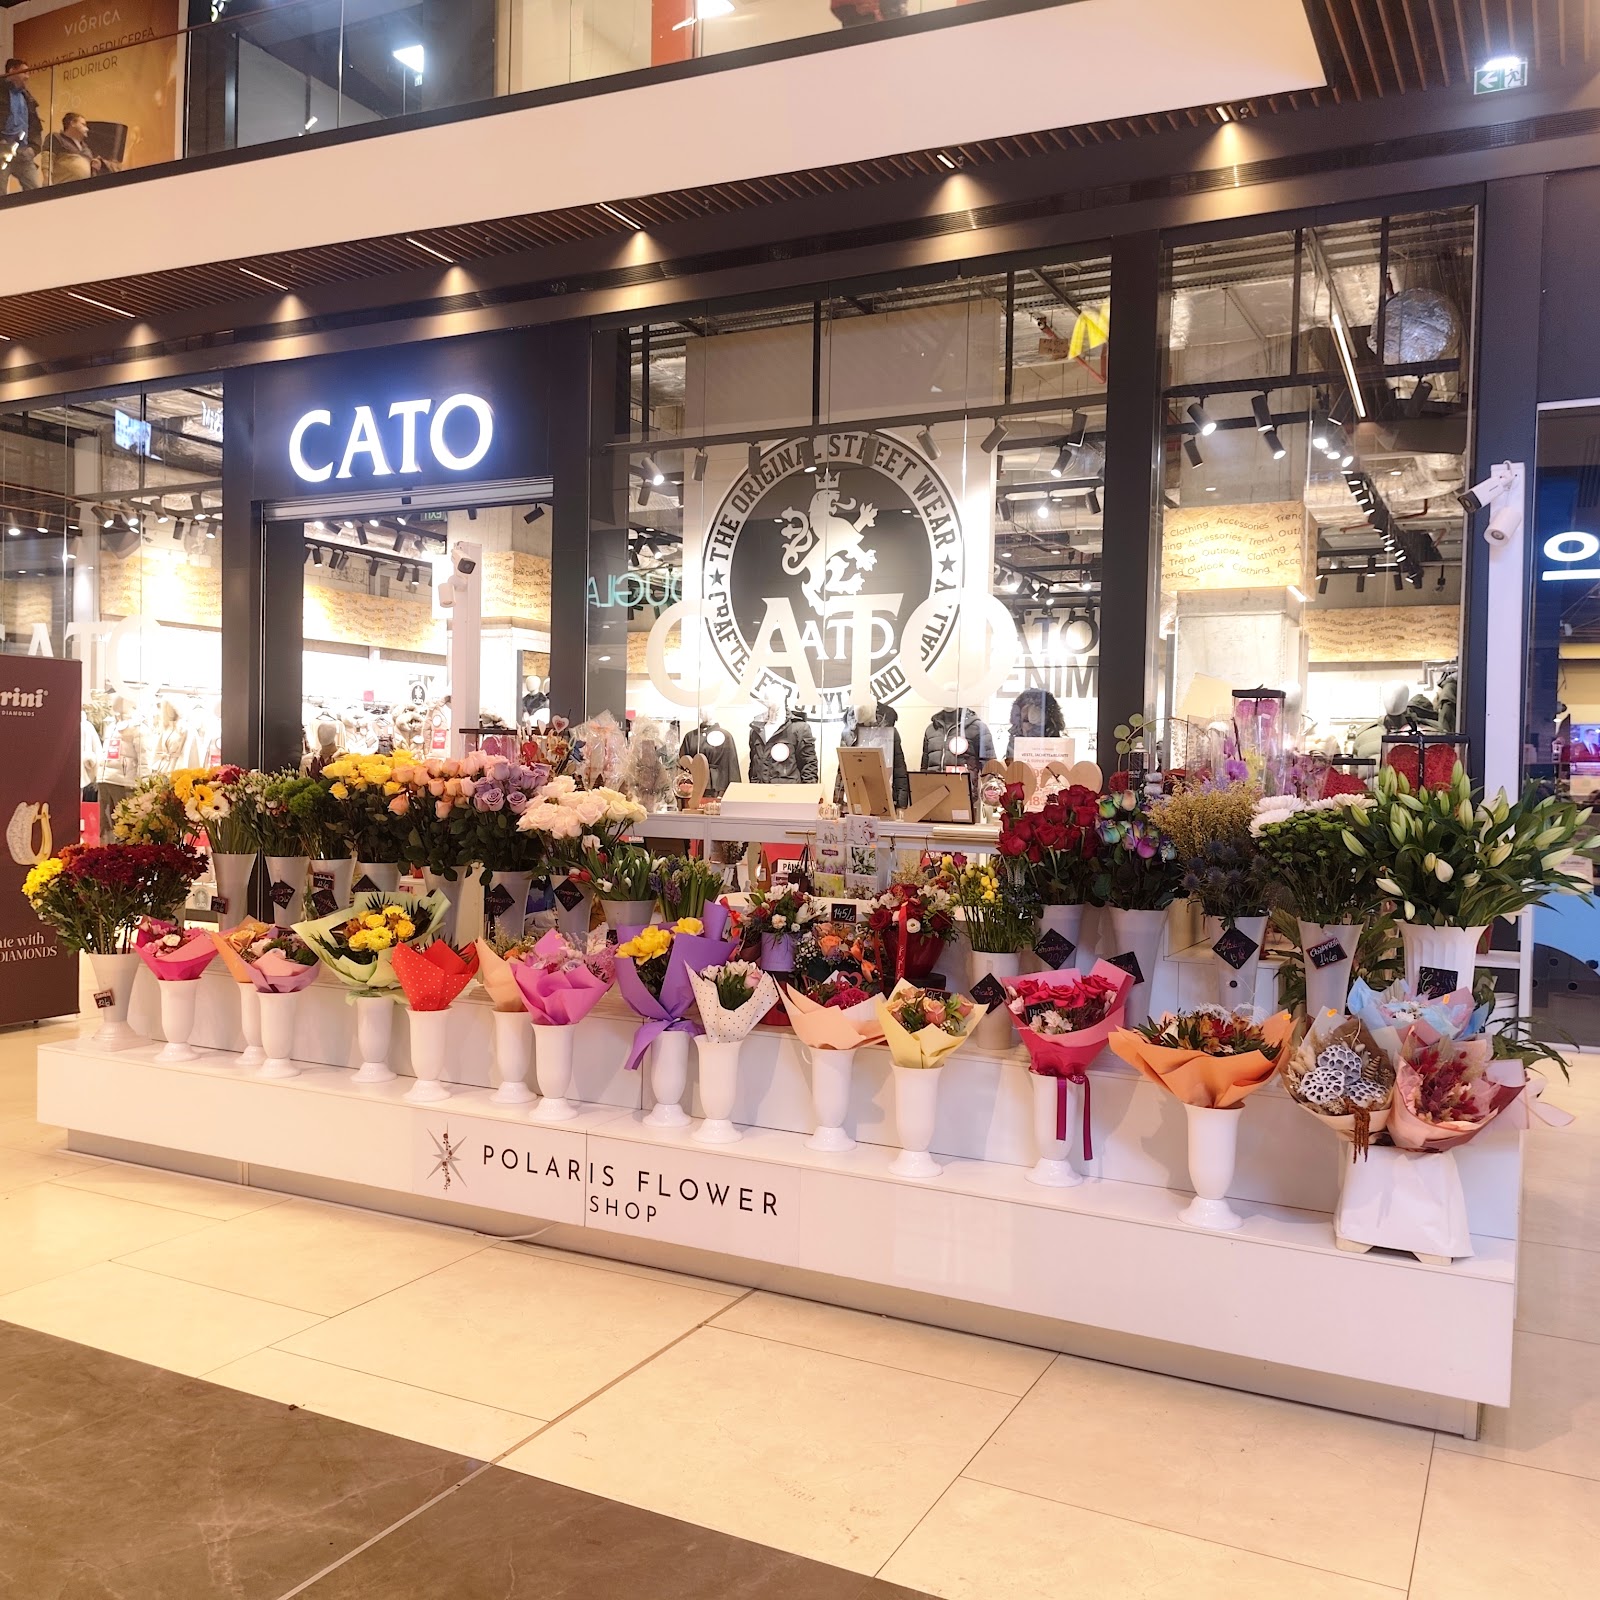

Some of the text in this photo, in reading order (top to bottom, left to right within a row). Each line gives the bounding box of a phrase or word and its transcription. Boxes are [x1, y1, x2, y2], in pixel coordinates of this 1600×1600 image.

[63, 55, 118, 82] RIDURILOR
[289, 393, 493, 482] CATO
[709, 513, 741, 563] THE
[912, 474, 956, 549] WEAR
[1170, 520, 1209, 537] Clothing
[1216, 516, 1270, 531] Accessories
[1188, 532, 1242, 547] Accessories
[1249, 534, 1274, 546] Trend
[1169, 555, 1196, 567] Trend
[1202, 548, 1241, 557] Outlook
[1247, 545, 1286, 561] Clothing
[1187, 562, 1224, 575] Outlook
[1232, 562, 1270, 575] Clothing
[708, 591, 751, 676] CRAFTE
[646, 592, 1018, 707] CATO
[17, 931, 45, 947] with
[484, 1145, 777, 1216] POLARIS FLOWER
[590, 1195, 657, 1222] SHOP
